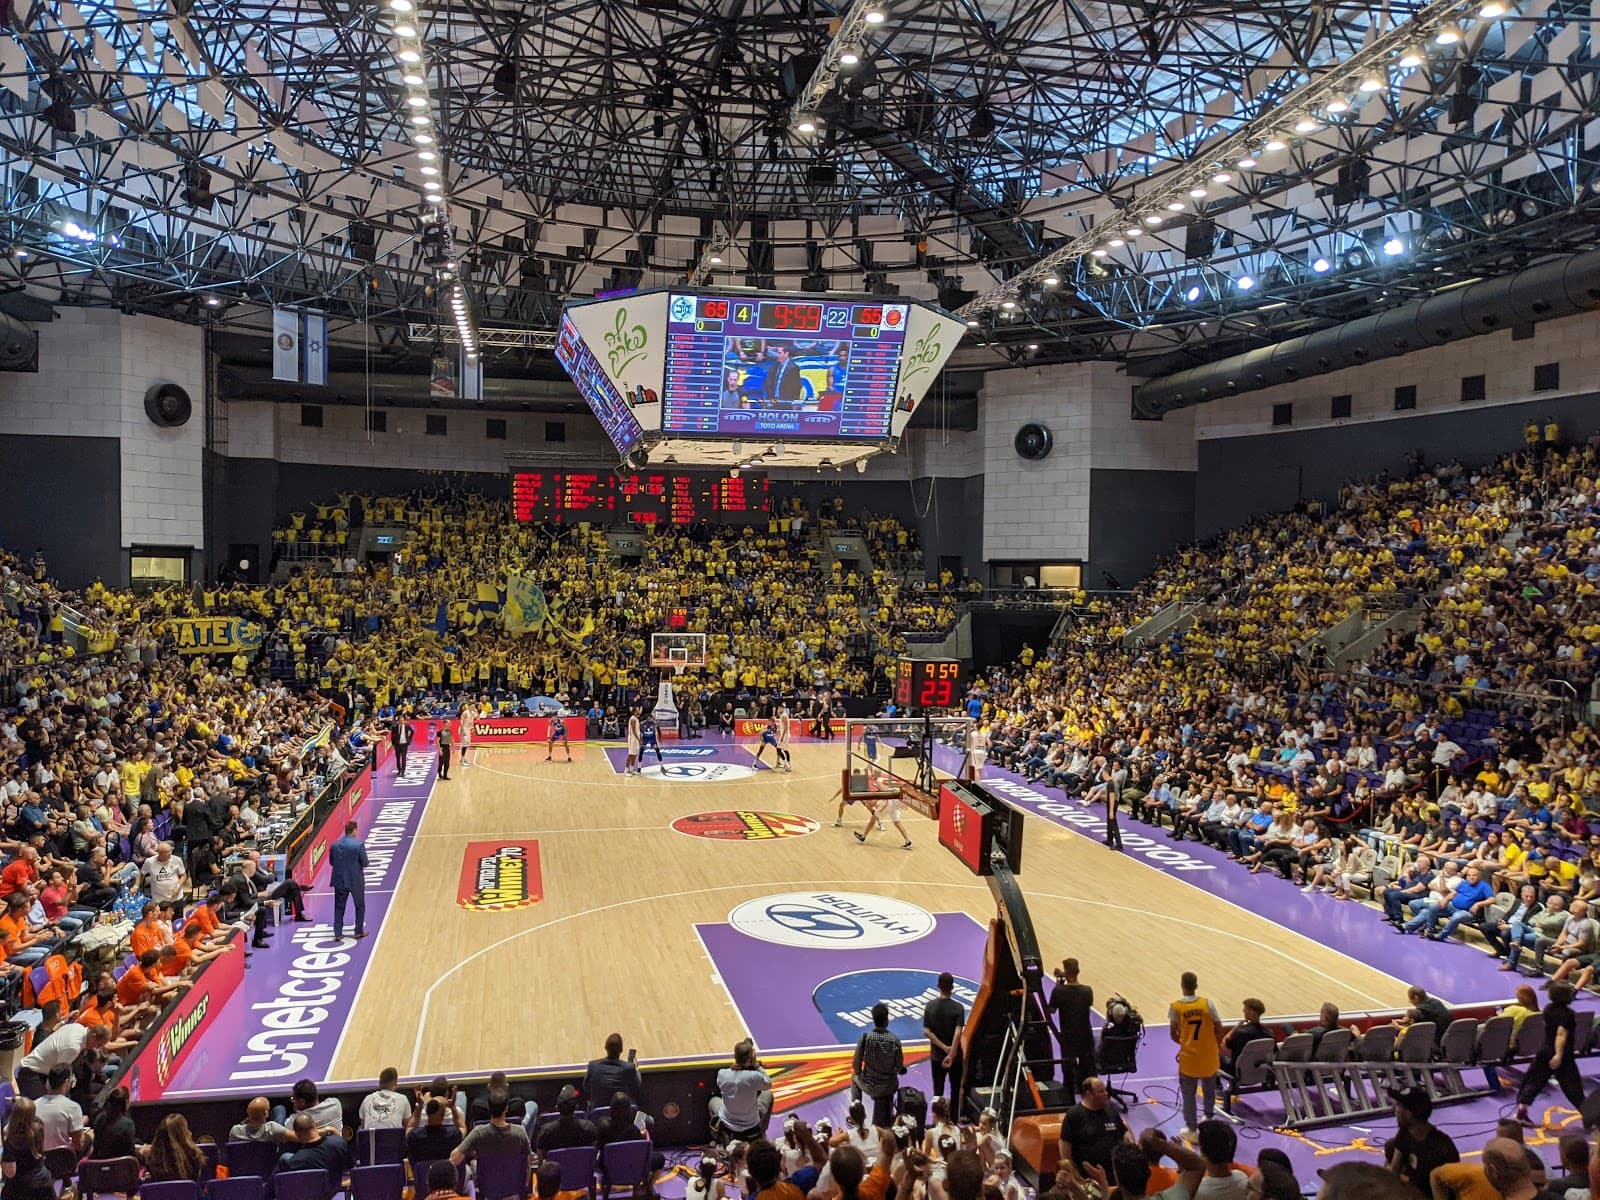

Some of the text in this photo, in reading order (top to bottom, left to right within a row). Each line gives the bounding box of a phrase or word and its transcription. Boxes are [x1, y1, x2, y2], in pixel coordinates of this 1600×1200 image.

[705, 302, 727, 318] 65
[738, 306, 748, 321] 4
[774, 304, 820, 329] 9:59
[829, 311, 845, 325] 22
[696, 321, 704, 331] 0
[870, 328, 877, 337] 0
[758, 412, 799, 423] HOLON
[921, 681, 952, 705] 23
[981, 778, 1057, 803] ARENA
[374, 801, 416, 824] ARENA
[1037, 803, 1107, 828] TOTO
[364, 826, 405, 848] TOTO
[479, 857, 523, 905] Winner
[811, 893, 920, 936] HYUNDAI
[229, 923, 366, 1081] unetcredit
[169, 990, 210, 1058] Winner
[1188, 1019, 1203, 1041] 7
